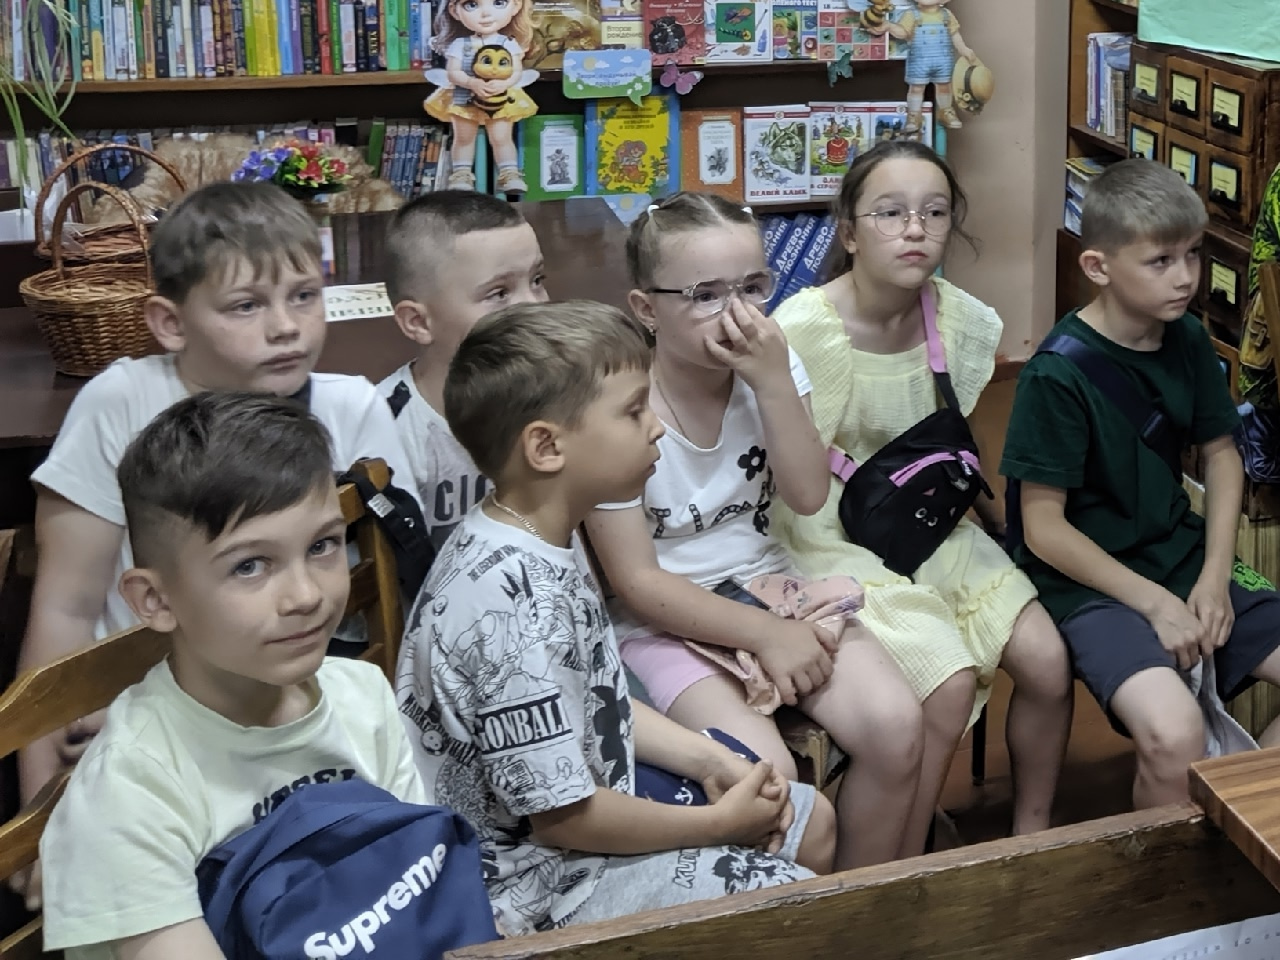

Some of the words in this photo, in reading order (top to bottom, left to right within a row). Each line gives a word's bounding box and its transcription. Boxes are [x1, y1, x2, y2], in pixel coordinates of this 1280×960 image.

[775, 227, 803, 271] ДРЕВО
[783, 217, 817, 275] ПОЗНАНИЯ
[803, 226, 829, 270] ДРЕВО
[304, 843, 447, 960] Supreme
